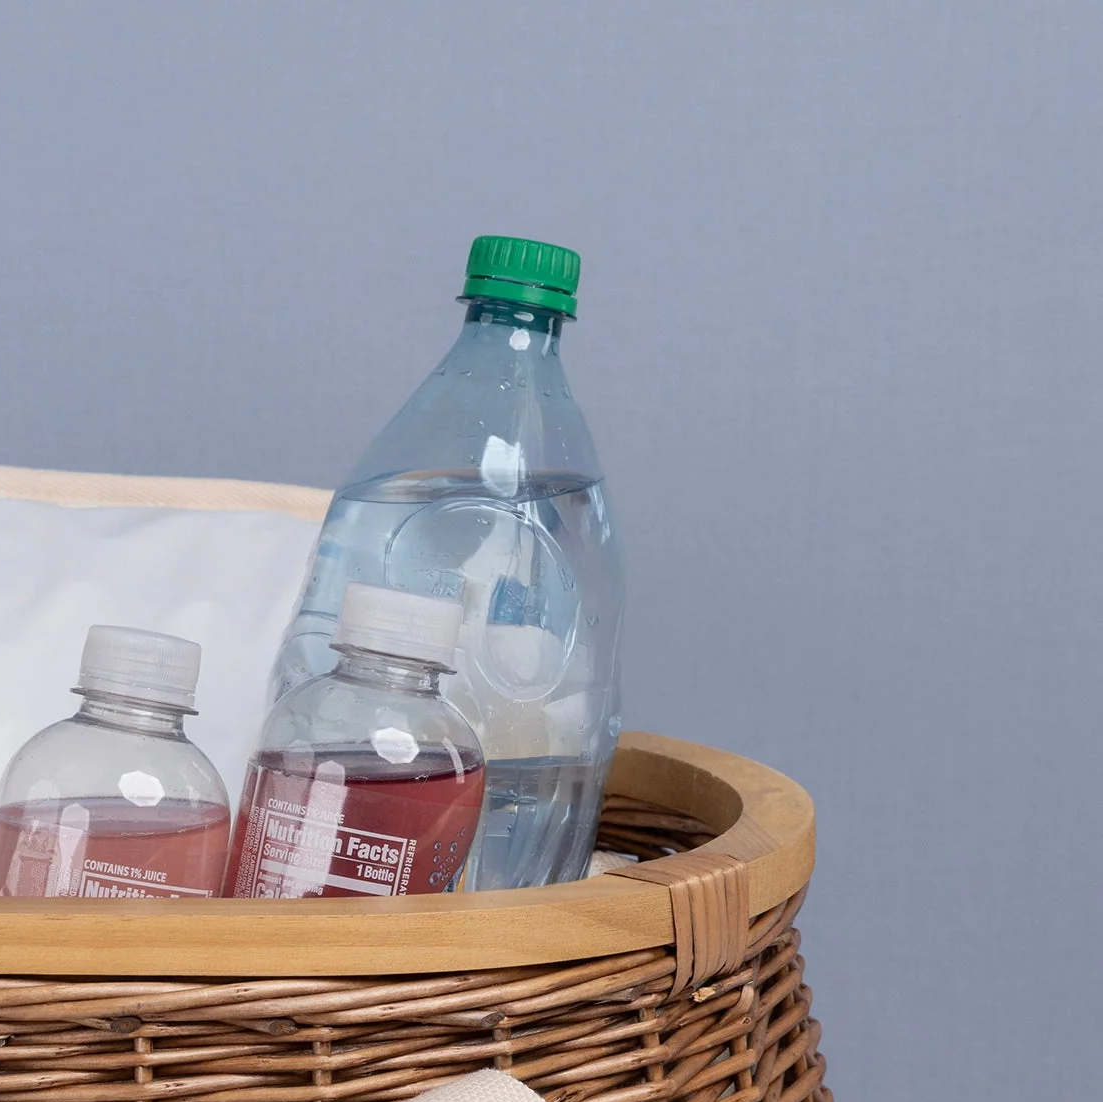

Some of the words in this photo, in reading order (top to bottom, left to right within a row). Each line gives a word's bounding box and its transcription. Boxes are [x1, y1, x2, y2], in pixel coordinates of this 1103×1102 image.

[267, 798, 307, 816] CONTAINS
[263, 843, 300, 866] Serving
[347, 836, 400, 864] Facts
[84, 858, 130, 877] CONTAINS
[130, 867, 142, 879] 1%
[142, 870, 168, 883] JUICE
[356, 864, 363, 877] 1
[364, 865, 395, 882] Bottle
